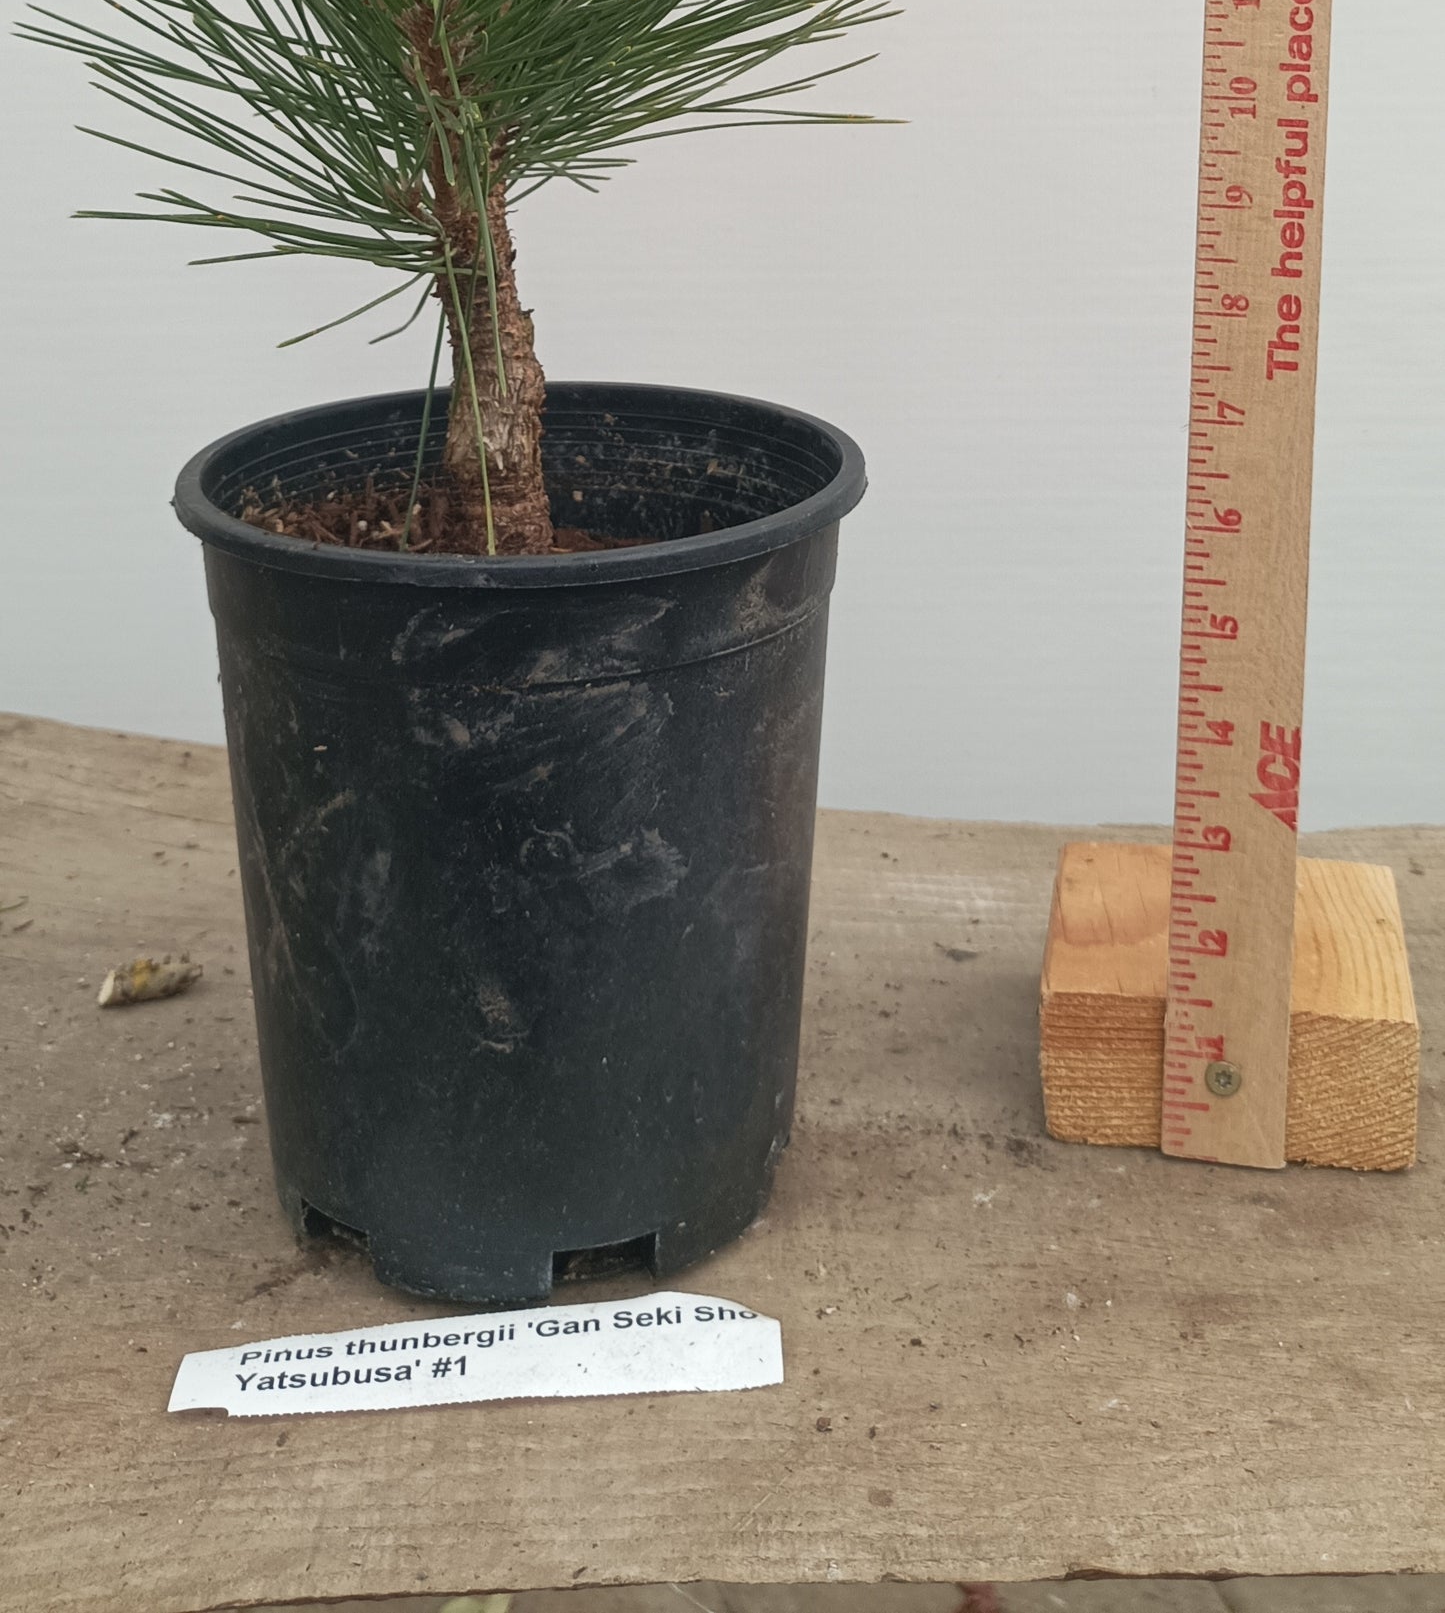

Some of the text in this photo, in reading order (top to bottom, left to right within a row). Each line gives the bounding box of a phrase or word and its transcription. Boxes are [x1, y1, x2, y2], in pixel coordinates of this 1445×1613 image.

[1228, 76, 1258, 120] 10
[1224, 184, 1254, 205] 9
[1271, 118, 1315, 278] helpful
[1220, 294, 1250, 313] 8
[1266, 294, 1303, 381] The
[1217, 401, 1246, 420] 7
[1213, 508, 1242, 526] 6
[1209, 614, 1239, 634] 5
[1205, 720, 1235, 741] 4
[1249, 720, 1301, 832] ACE
[1202, 825, 1232, 848] 3
[1198, 929, 1228, 954] 2
[239, 1304, 759, 1367] Pinus thunbergii 'Gan Seki Sho
[234, 1355, 469, 1392] Yatsubusa' #1
